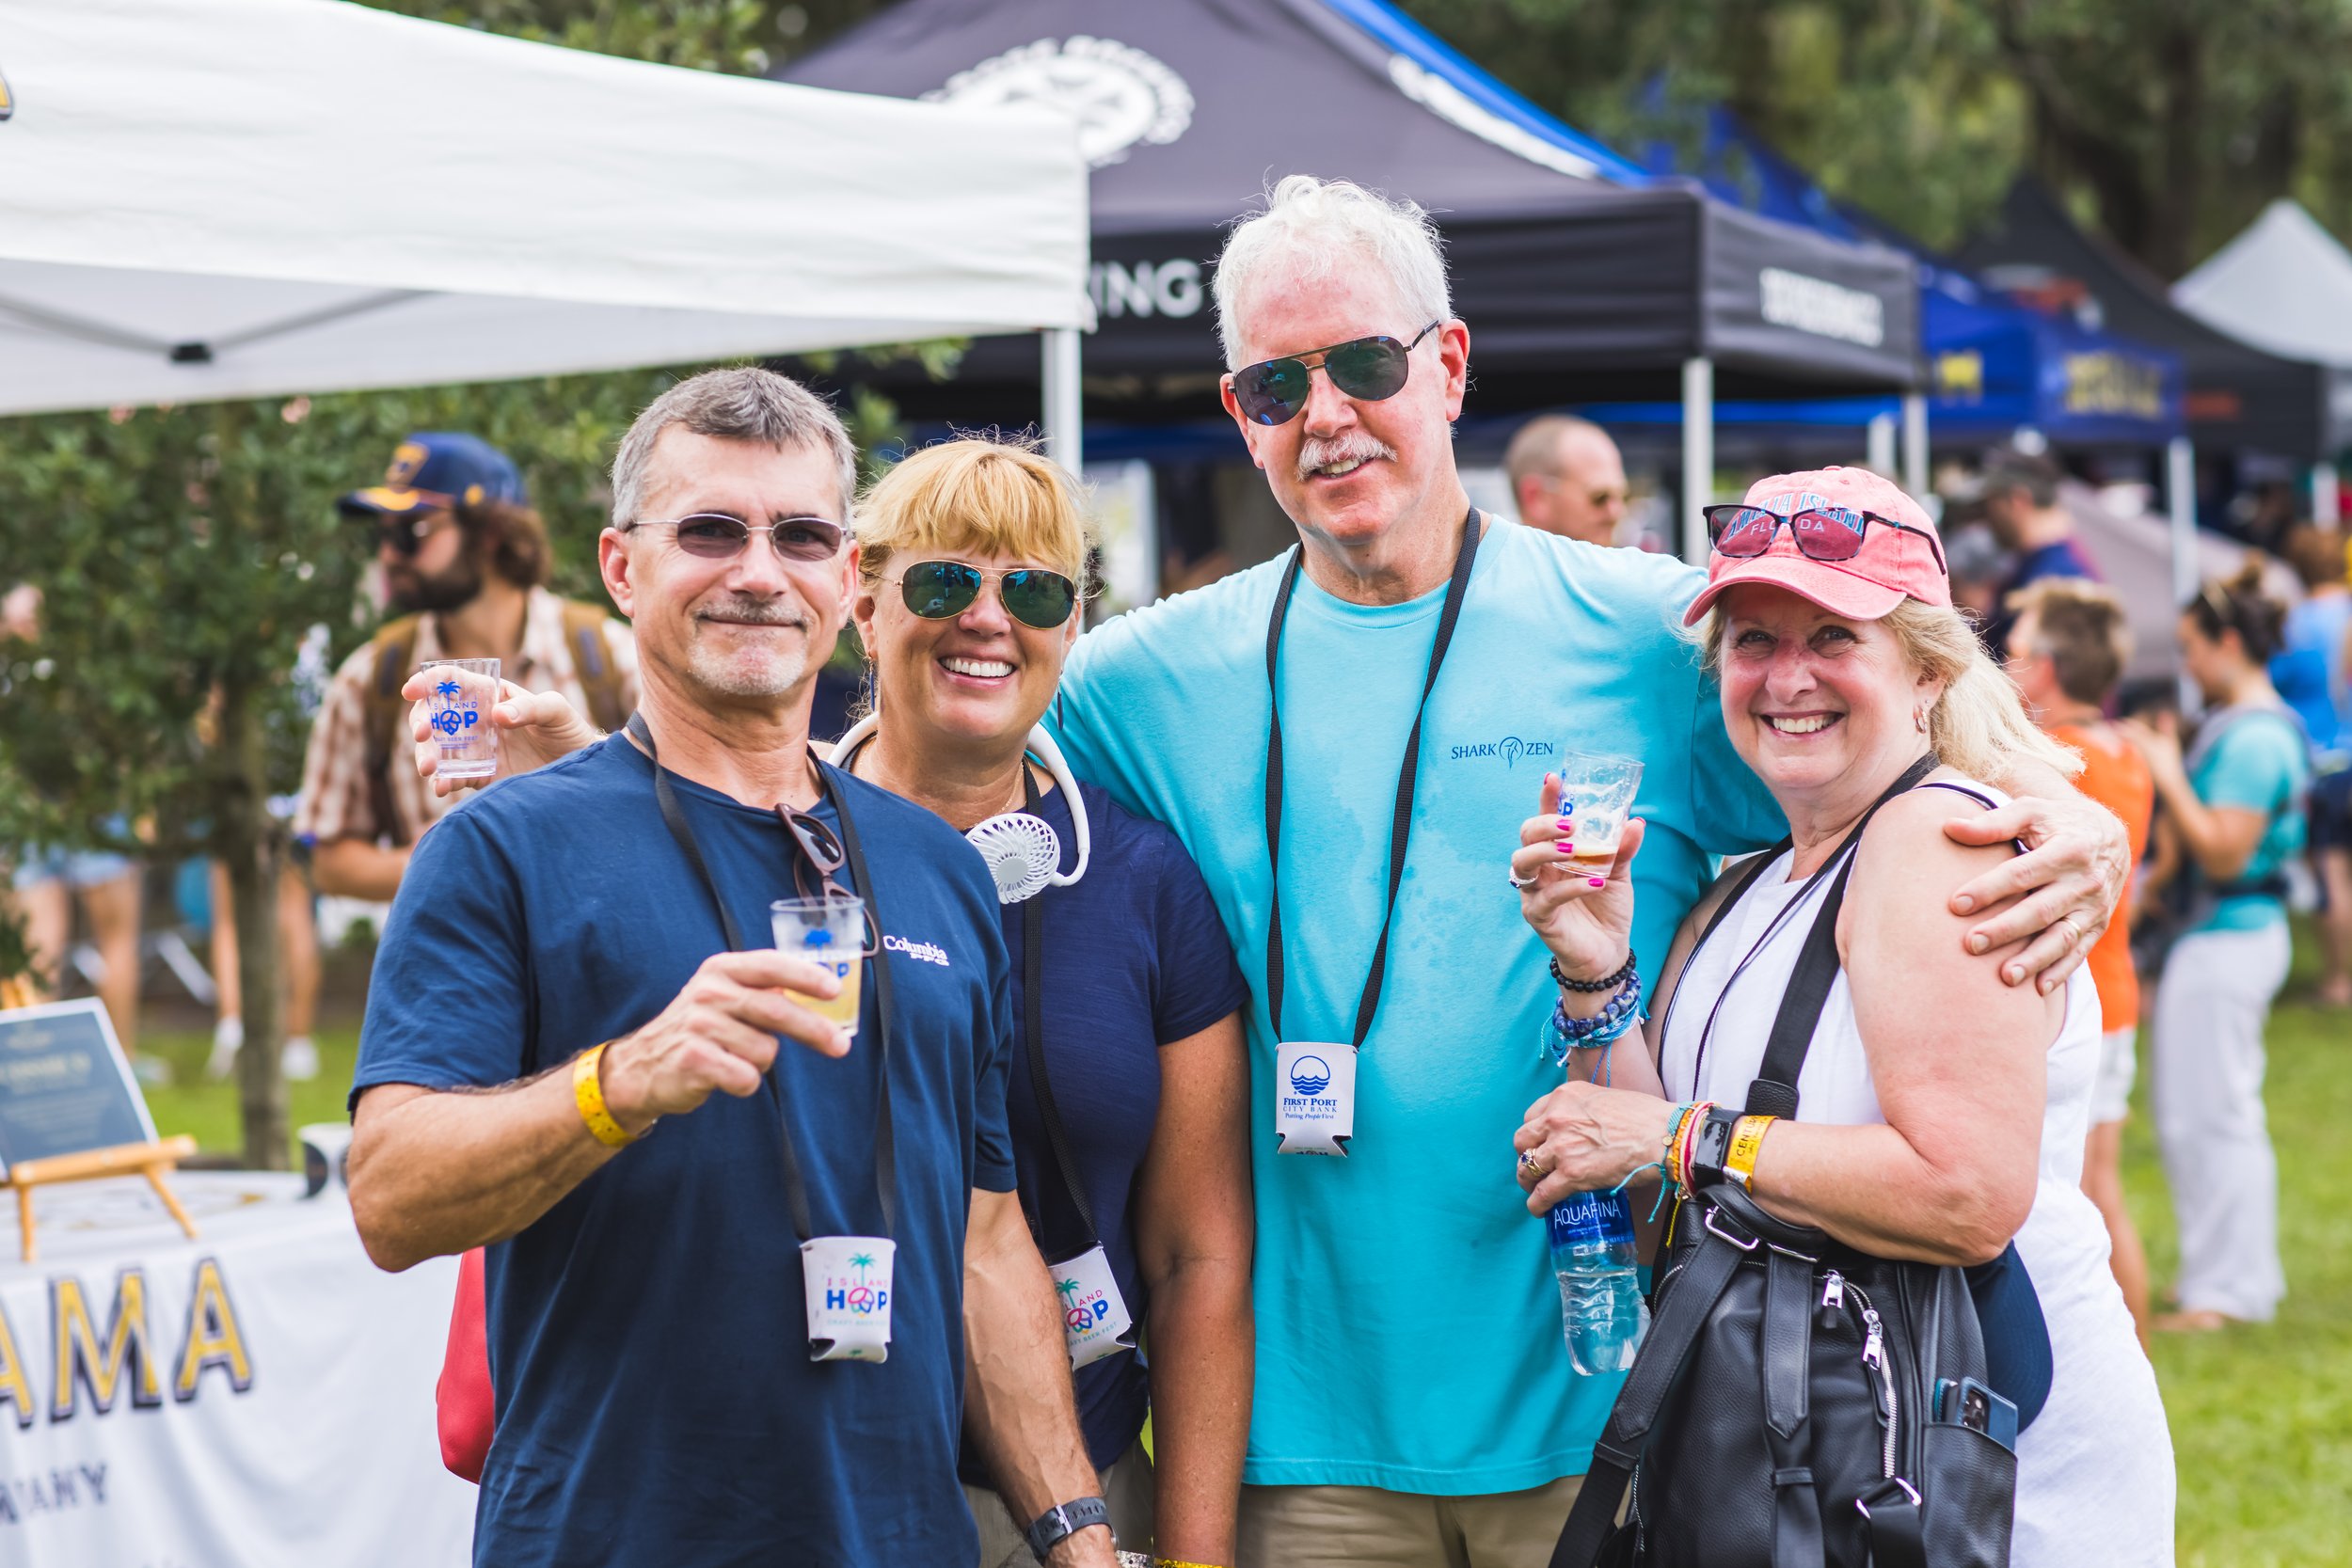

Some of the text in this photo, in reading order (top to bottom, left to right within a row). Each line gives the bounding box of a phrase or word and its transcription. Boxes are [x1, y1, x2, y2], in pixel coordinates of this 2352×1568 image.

[1750, 518, 1825, 536] FLODA
[1451, 742, 1553, 760] SHARK ZEN
[883, 935, 947, 960] Columbia
[1283, 1097, 1338, 1106] FIRST PORT
[1554, 1198, 1623, 1229] AQUAFINA
[1067, 1299, 1109, 1334] OP
